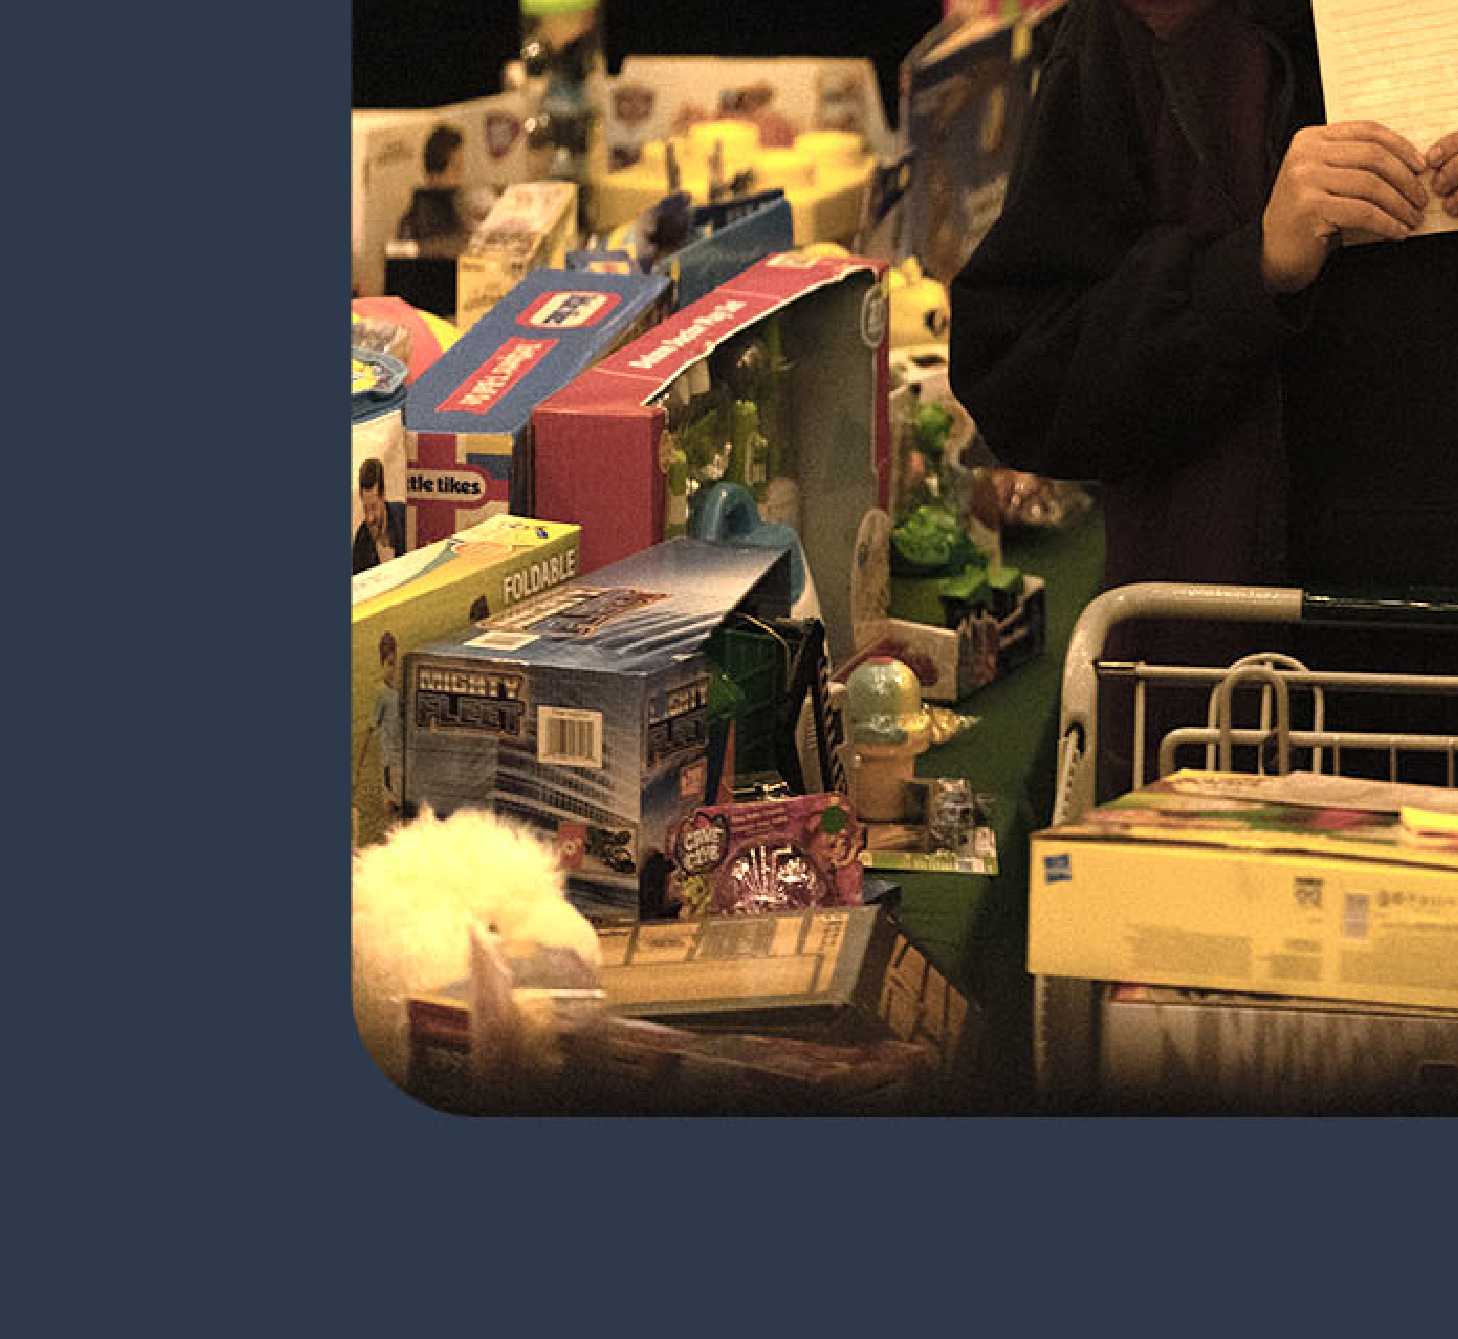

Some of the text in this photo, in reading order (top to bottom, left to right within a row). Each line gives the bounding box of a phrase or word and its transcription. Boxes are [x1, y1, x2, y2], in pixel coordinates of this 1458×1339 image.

[437, 475, 482, 495] tikes
[503, 547, 578, 607] FOLDABLE
[418, 670, 520, 700] MIGHTY
